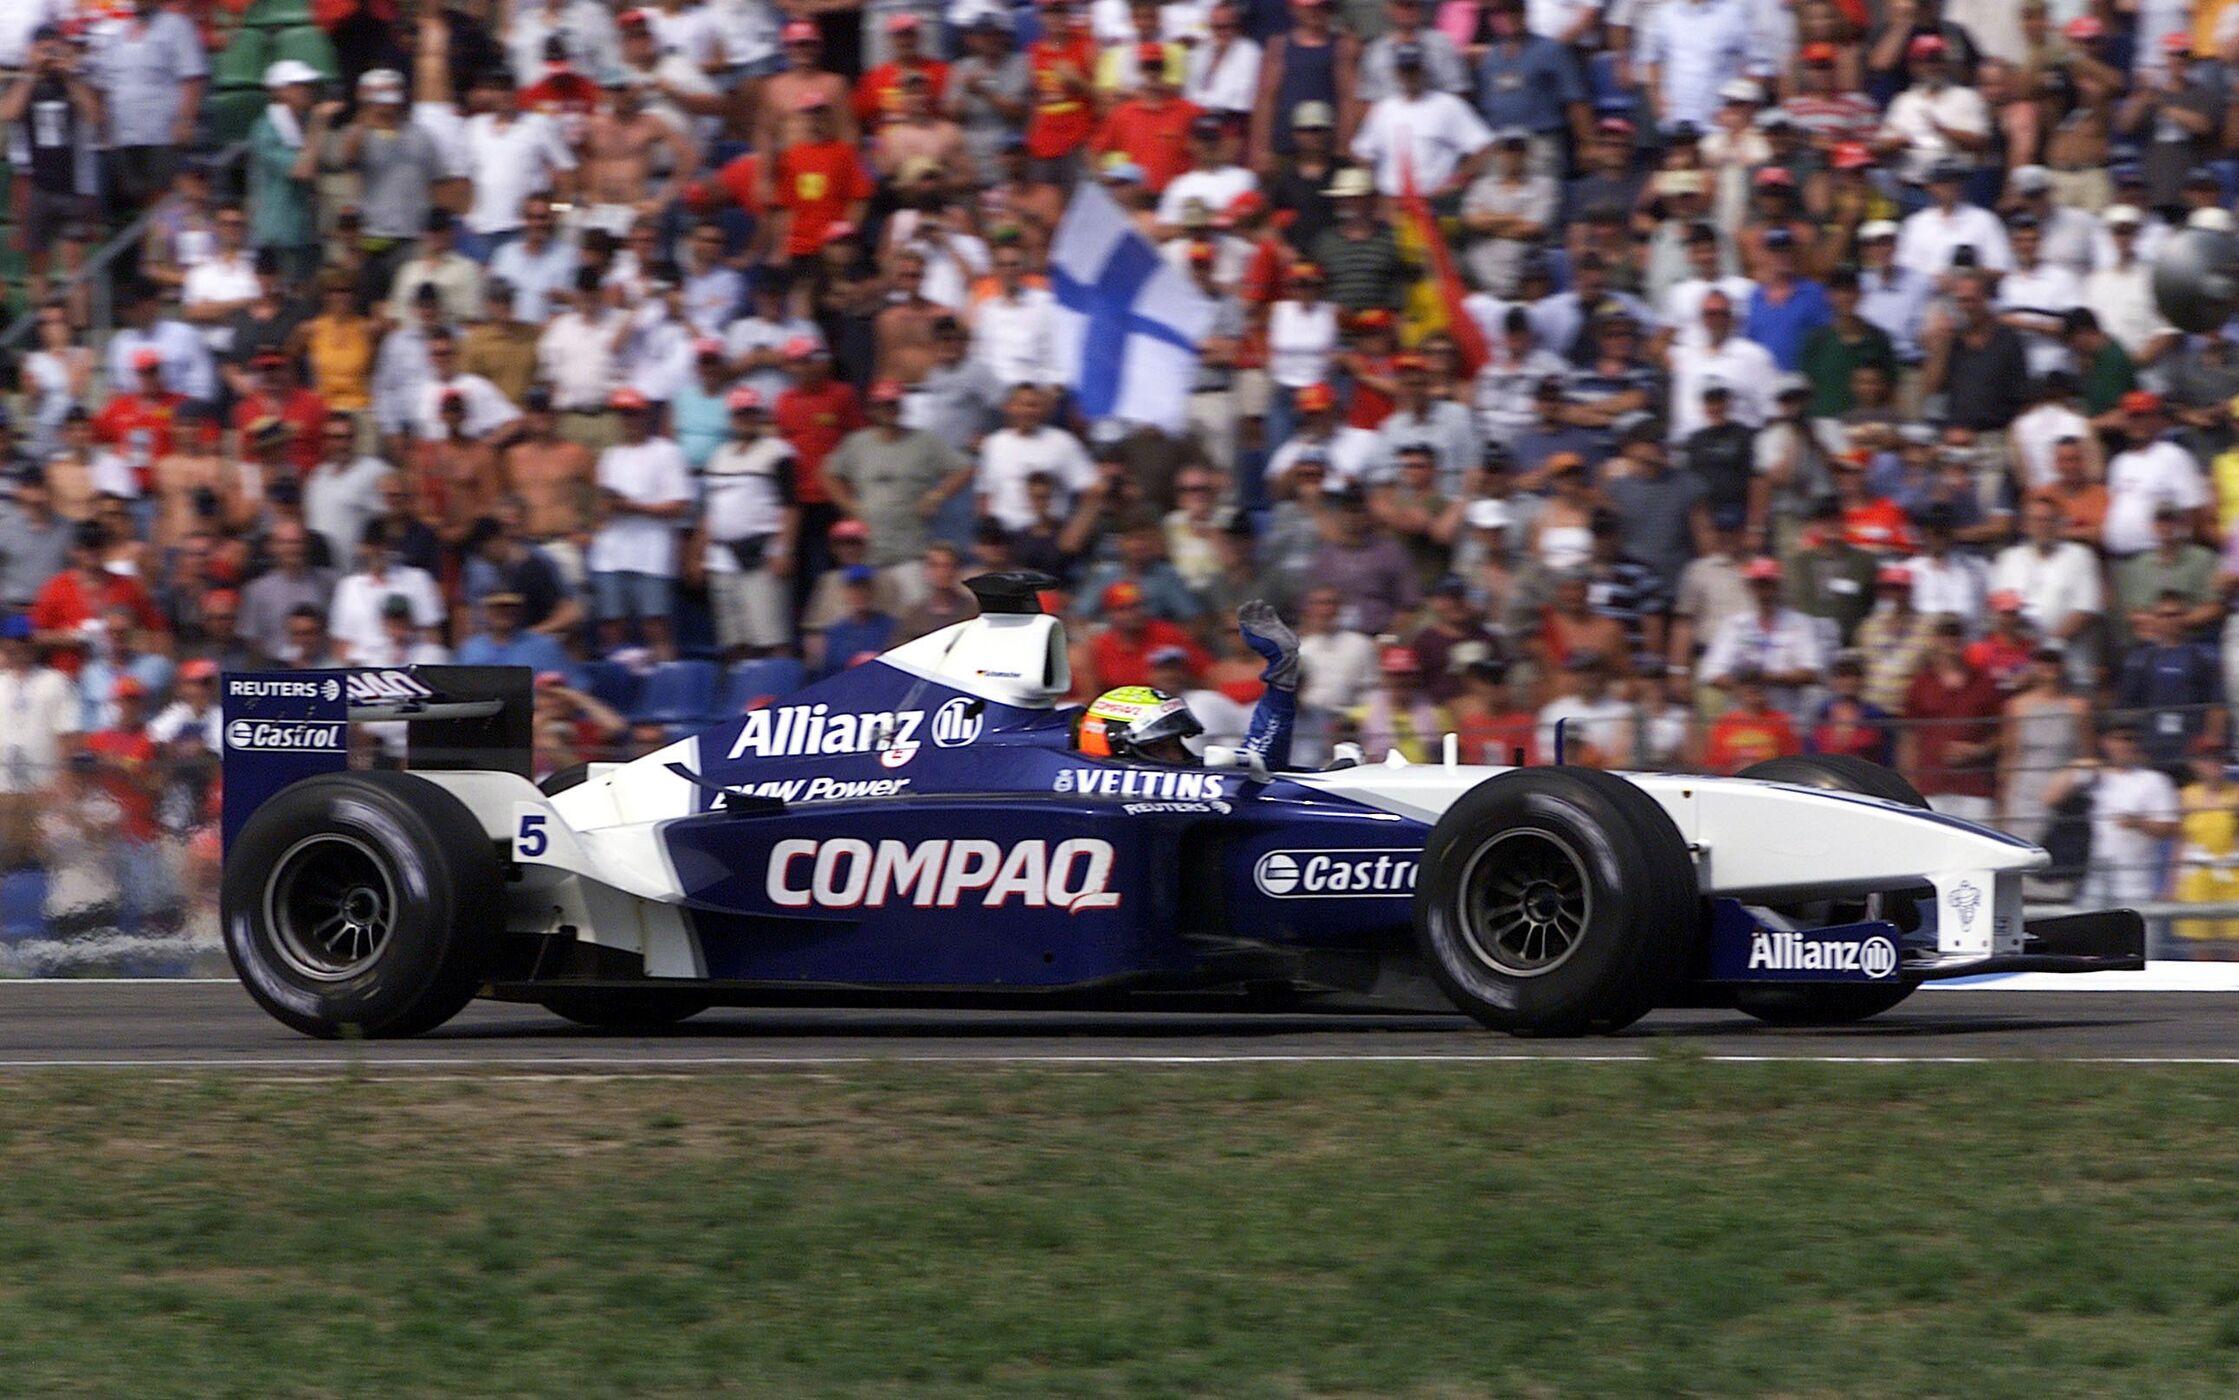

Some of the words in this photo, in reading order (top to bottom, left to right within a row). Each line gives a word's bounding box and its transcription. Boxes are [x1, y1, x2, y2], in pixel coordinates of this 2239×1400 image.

[229, 681, 318, 697] REUTERS
[253, 724, 338, 749] Castrol
[727, 703, 925, 759] Allianz
[803, 777, 911, 801] Power
[1076, 769, 1224, 799] VELTINS
[1122, 803, 1211, 815] REUTERS
[518, 815, 548, 857] 5
[766, 838, 1121, 915] COMPAQ
[1748, 932, 1861, 971] Allianz
